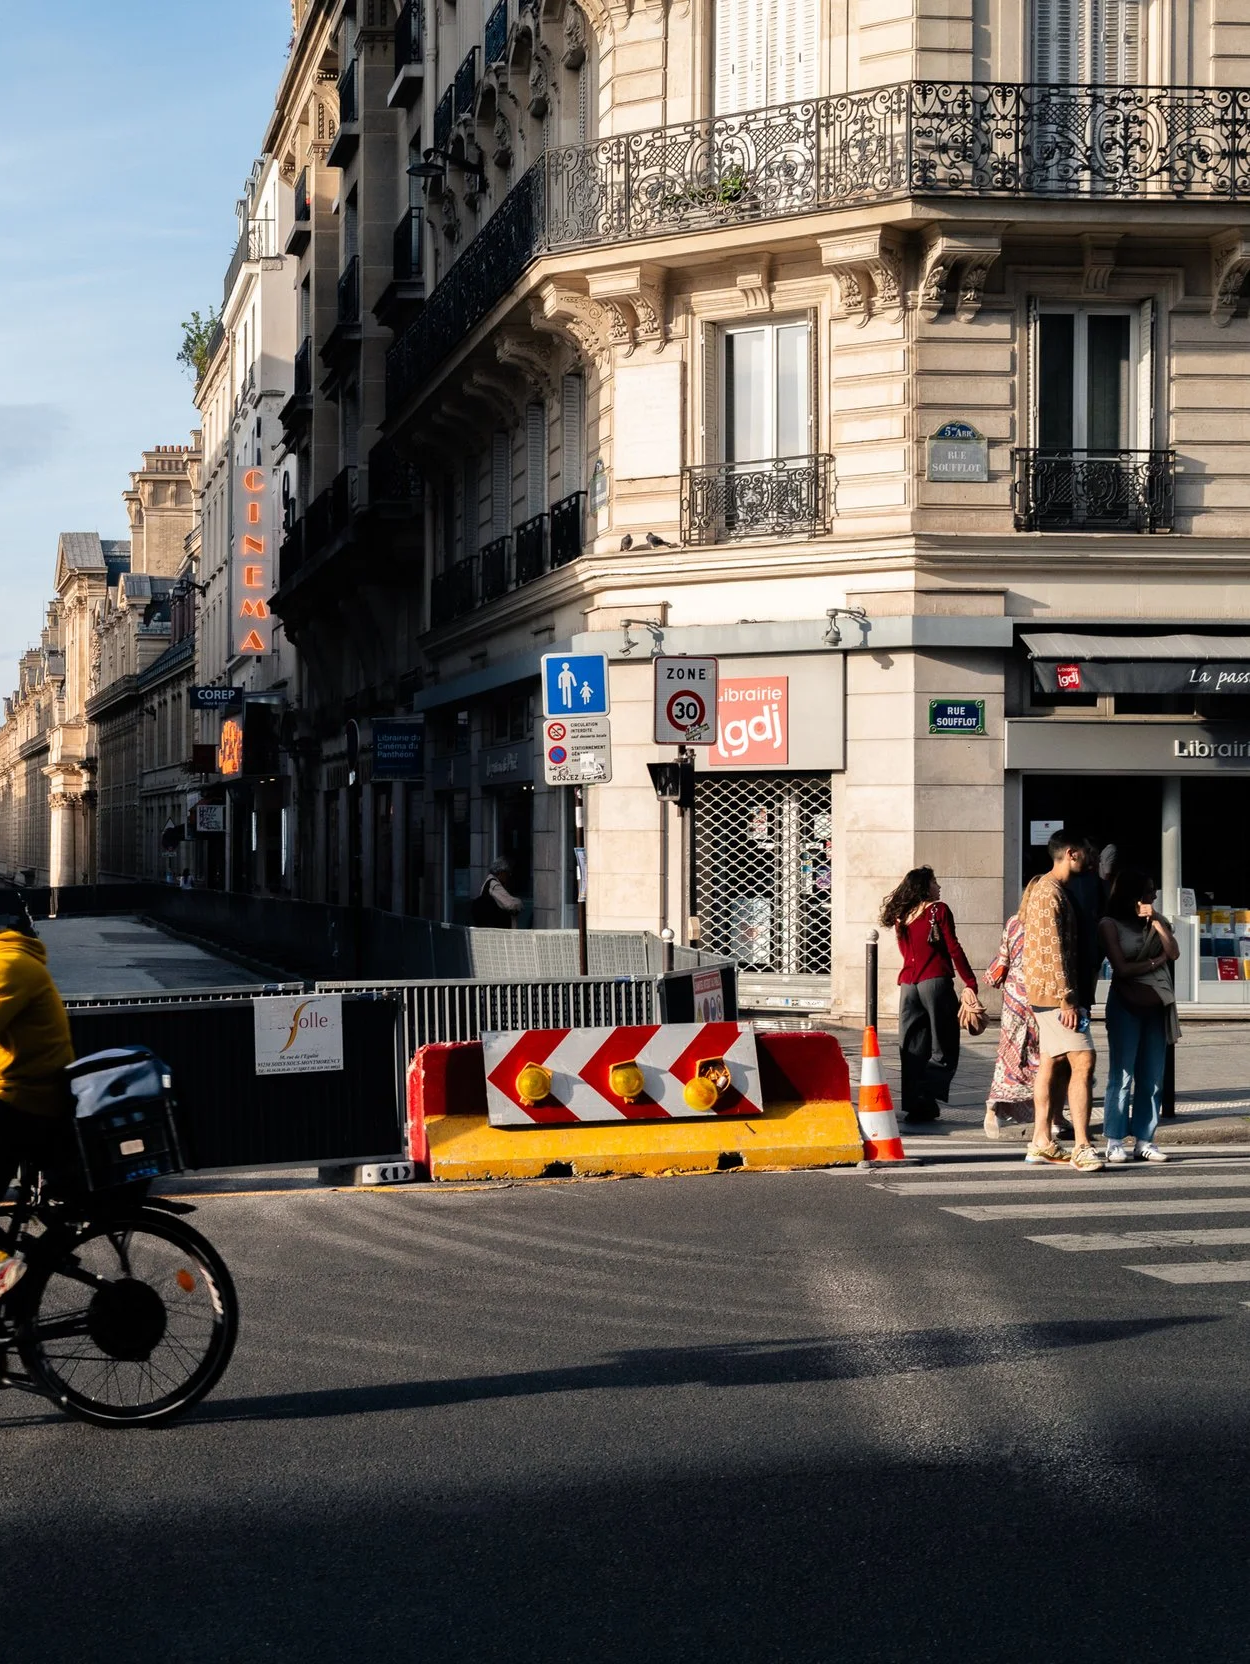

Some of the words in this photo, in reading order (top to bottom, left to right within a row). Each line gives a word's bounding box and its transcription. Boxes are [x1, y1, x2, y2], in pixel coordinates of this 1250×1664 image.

[947, 451, 967, 459] RUE
[932, 463, 981, 472] SOUFFLOT
[239, 469, 267, 650] CINEMA
[666, 668, 706, 680] ZONE
[1189, 669, 1212, 683] La
[1215, 672, 1250, 691] pass
[197, 689, 236, 700] COREP
[674, 702, 698, 720] 30
[947, 706, 966, 715] RUE
[936, 717, 977, 726] SOUFFLOT
[377, 742, 407, 750] Cinéma
[408, 742, 419, 750] du
[377, 750, 414, 758] Panthéon
